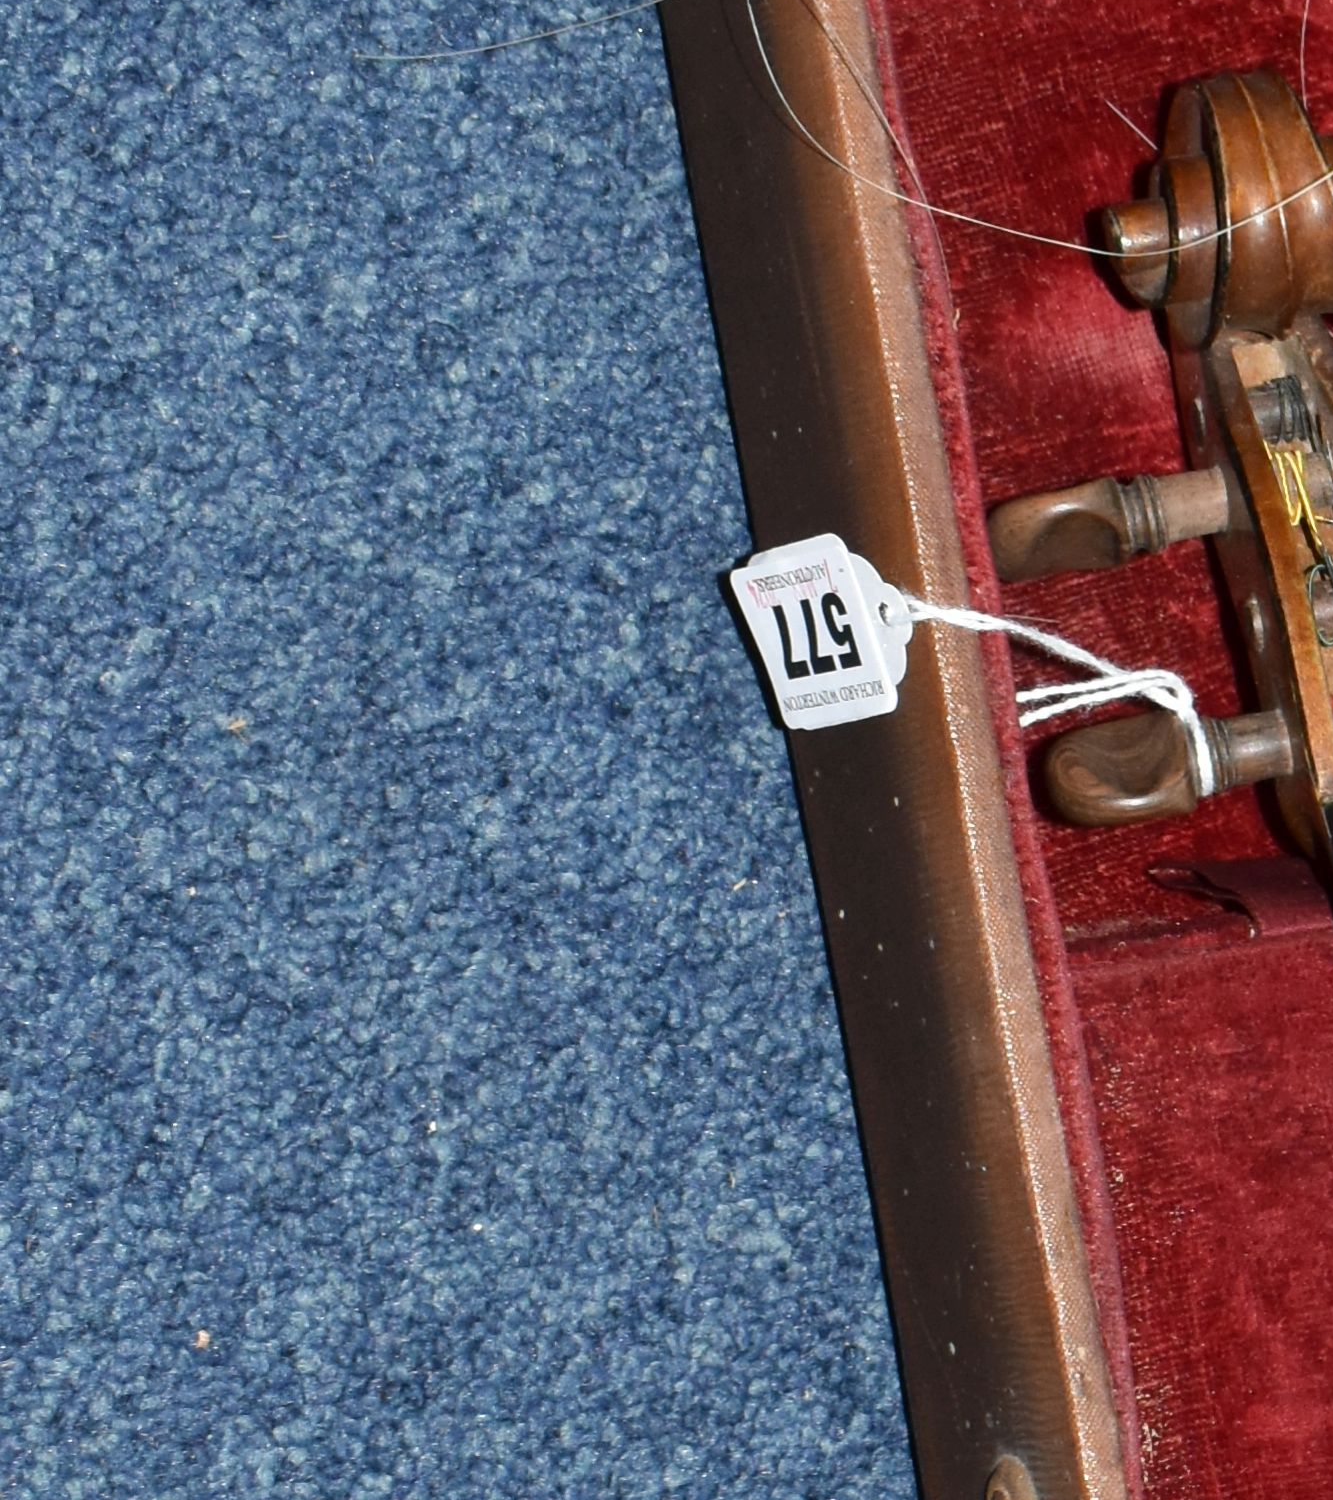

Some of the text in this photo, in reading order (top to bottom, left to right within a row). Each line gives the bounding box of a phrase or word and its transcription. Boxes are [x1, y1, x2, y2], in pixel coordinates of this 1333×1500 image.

[751, 564, 826, 593] AUCTIONEERS
[772, 592, 863, 680] 577
[783, 680, 885, 712] RICHARD WINTERTON
